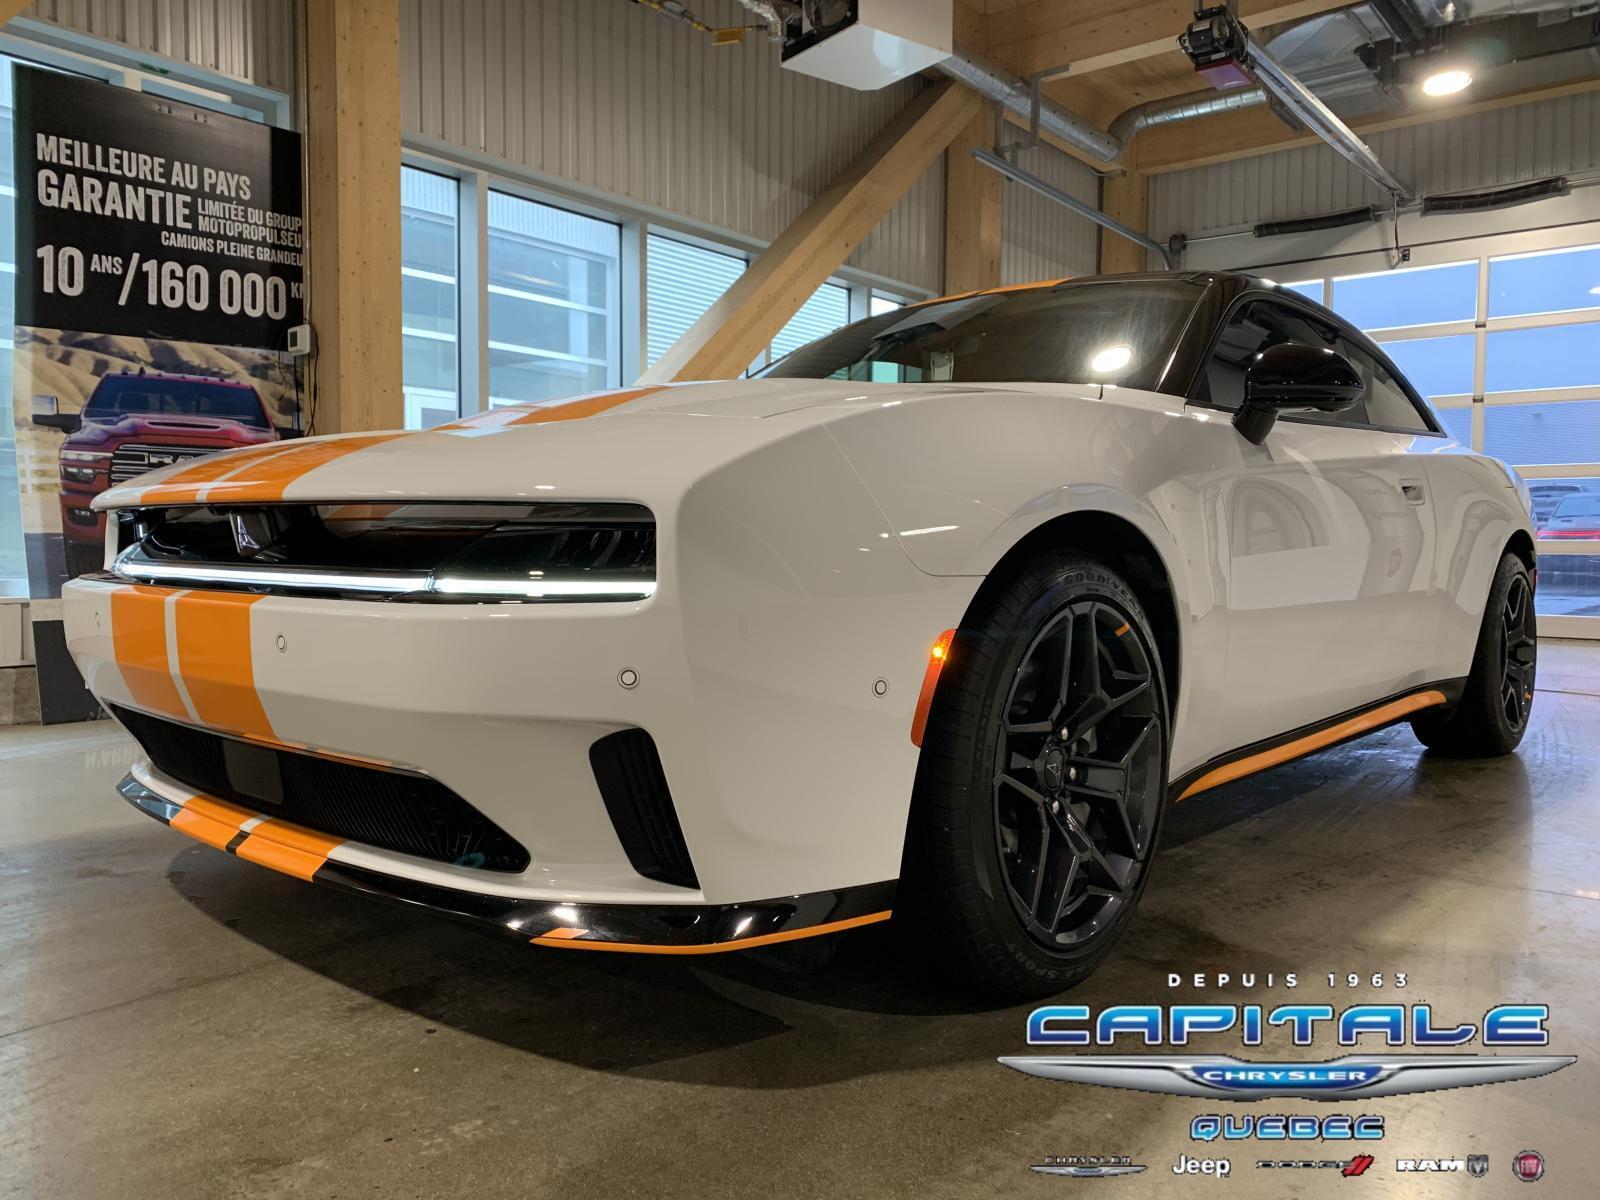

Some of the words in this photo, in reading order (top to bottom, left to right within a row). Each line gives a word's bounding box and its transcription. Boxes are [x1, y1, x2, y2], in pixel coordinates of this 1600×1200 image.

[37, 132, 166, 184] MEILLEURE
[171, 160, 199, 191] AU
[203, 167, 251, 201] PAYS
[37, 169, 193, 230] GARANTIE
[197, 197, 245, 222] LIMITÉE
[247, 207, 264, 225] DU
[161, 231, 214, 253] CAMIONS
[216, 241, 254, 259] PLEINE
[37, 244, 85, 297] 10
[90, 253, 123, 275] ANS
[219, 269, 287, 320] 000
